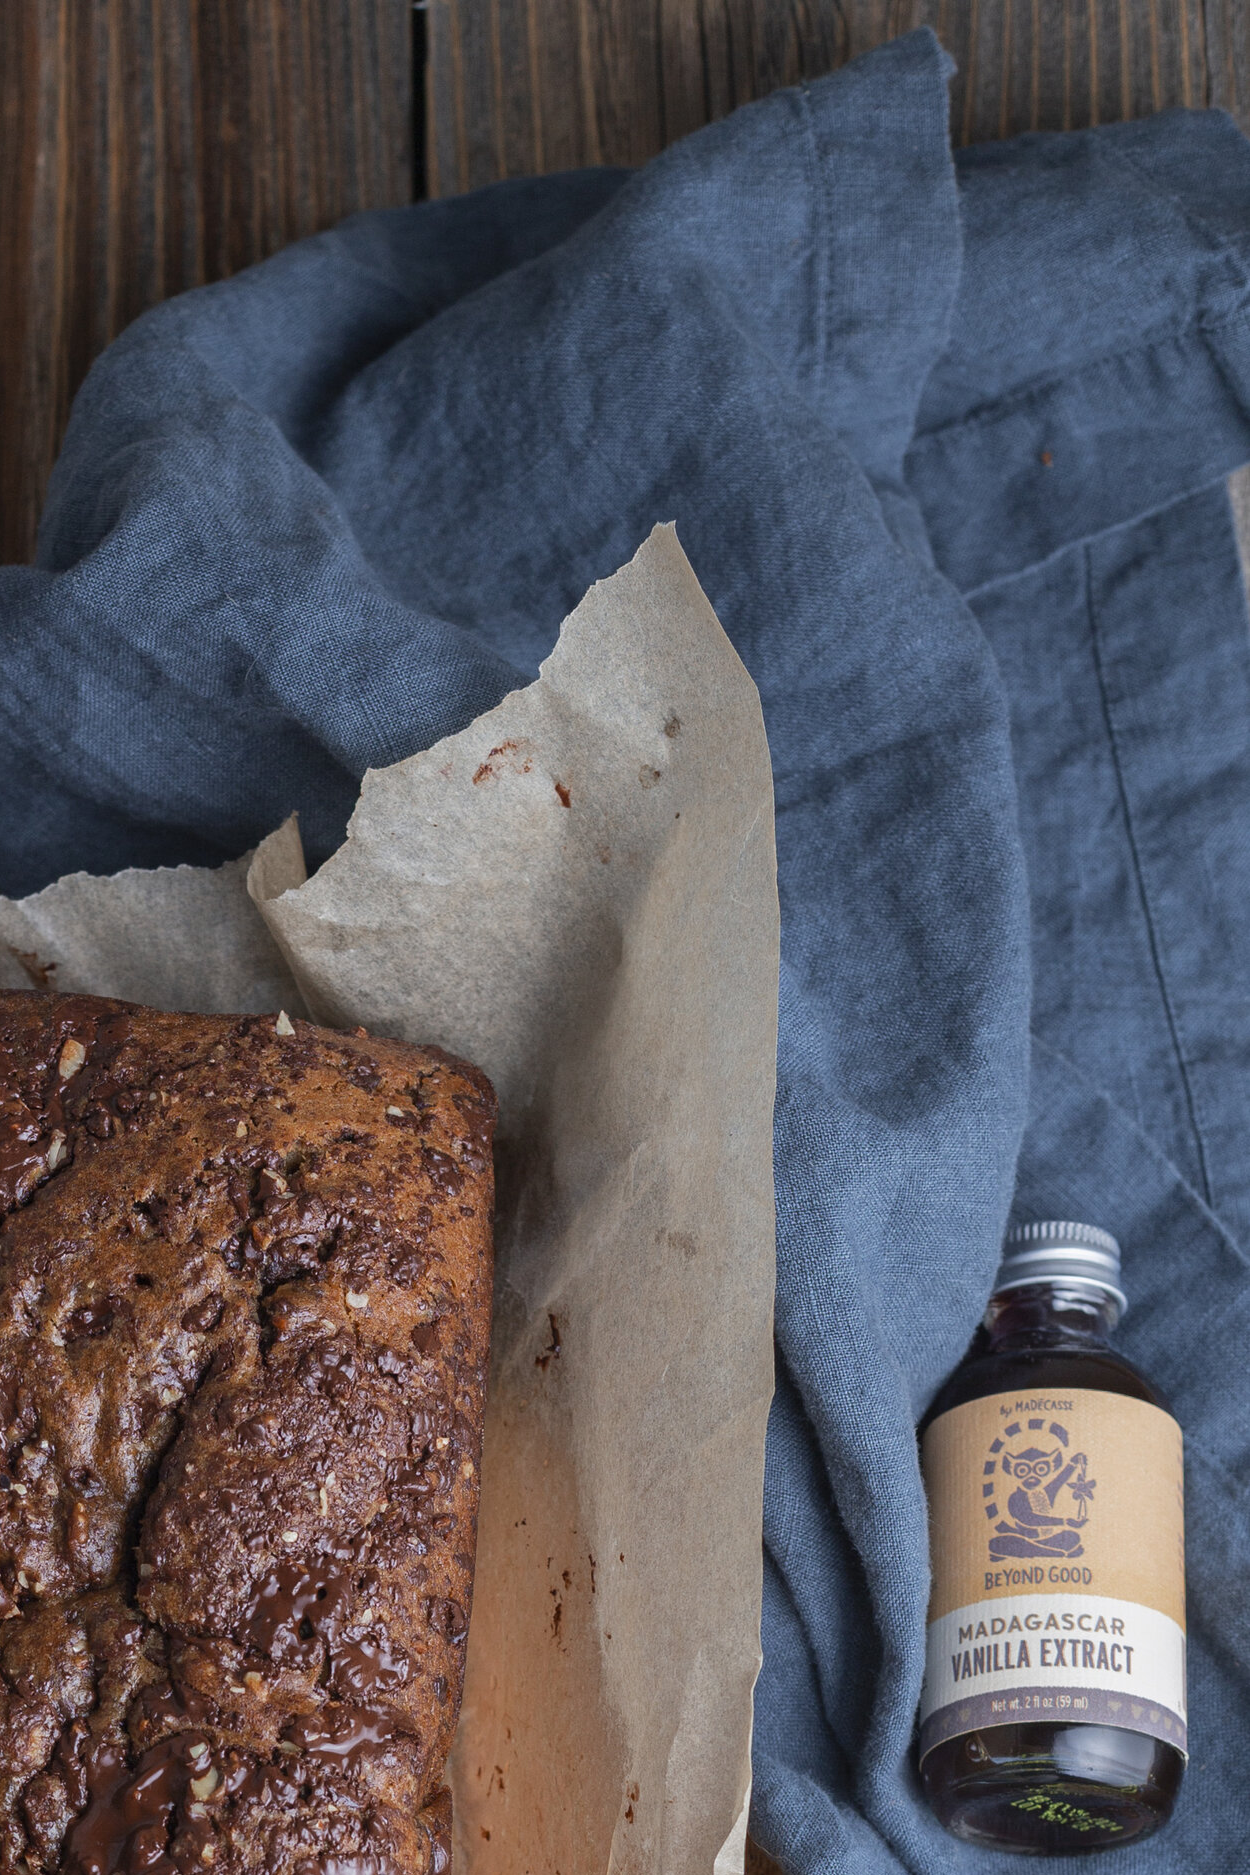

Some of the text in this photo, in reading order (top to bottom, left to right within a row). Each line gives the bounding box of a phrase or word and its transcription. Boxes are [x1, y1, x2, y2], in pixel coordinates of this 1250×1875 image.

[1000, 1404, 1012, 1419] by
[1048, 1565, 1092, 1585] GOOD
[957, 1612, 1125, 1645] MADAGASCAR
[951, 1638, 1134, 1683] VANILLA EXTRACT
[991, 1699, 1007, 1713] Net
[1009, 1697, 1023, 1711] wt.
[1024, 1696, 1032, 1709] 2
[1042, 1697, 1054, 1708] oz
[1055, 1696, 1072, 1709] (59
[1073, 1696, 1090, 1710] ml)
